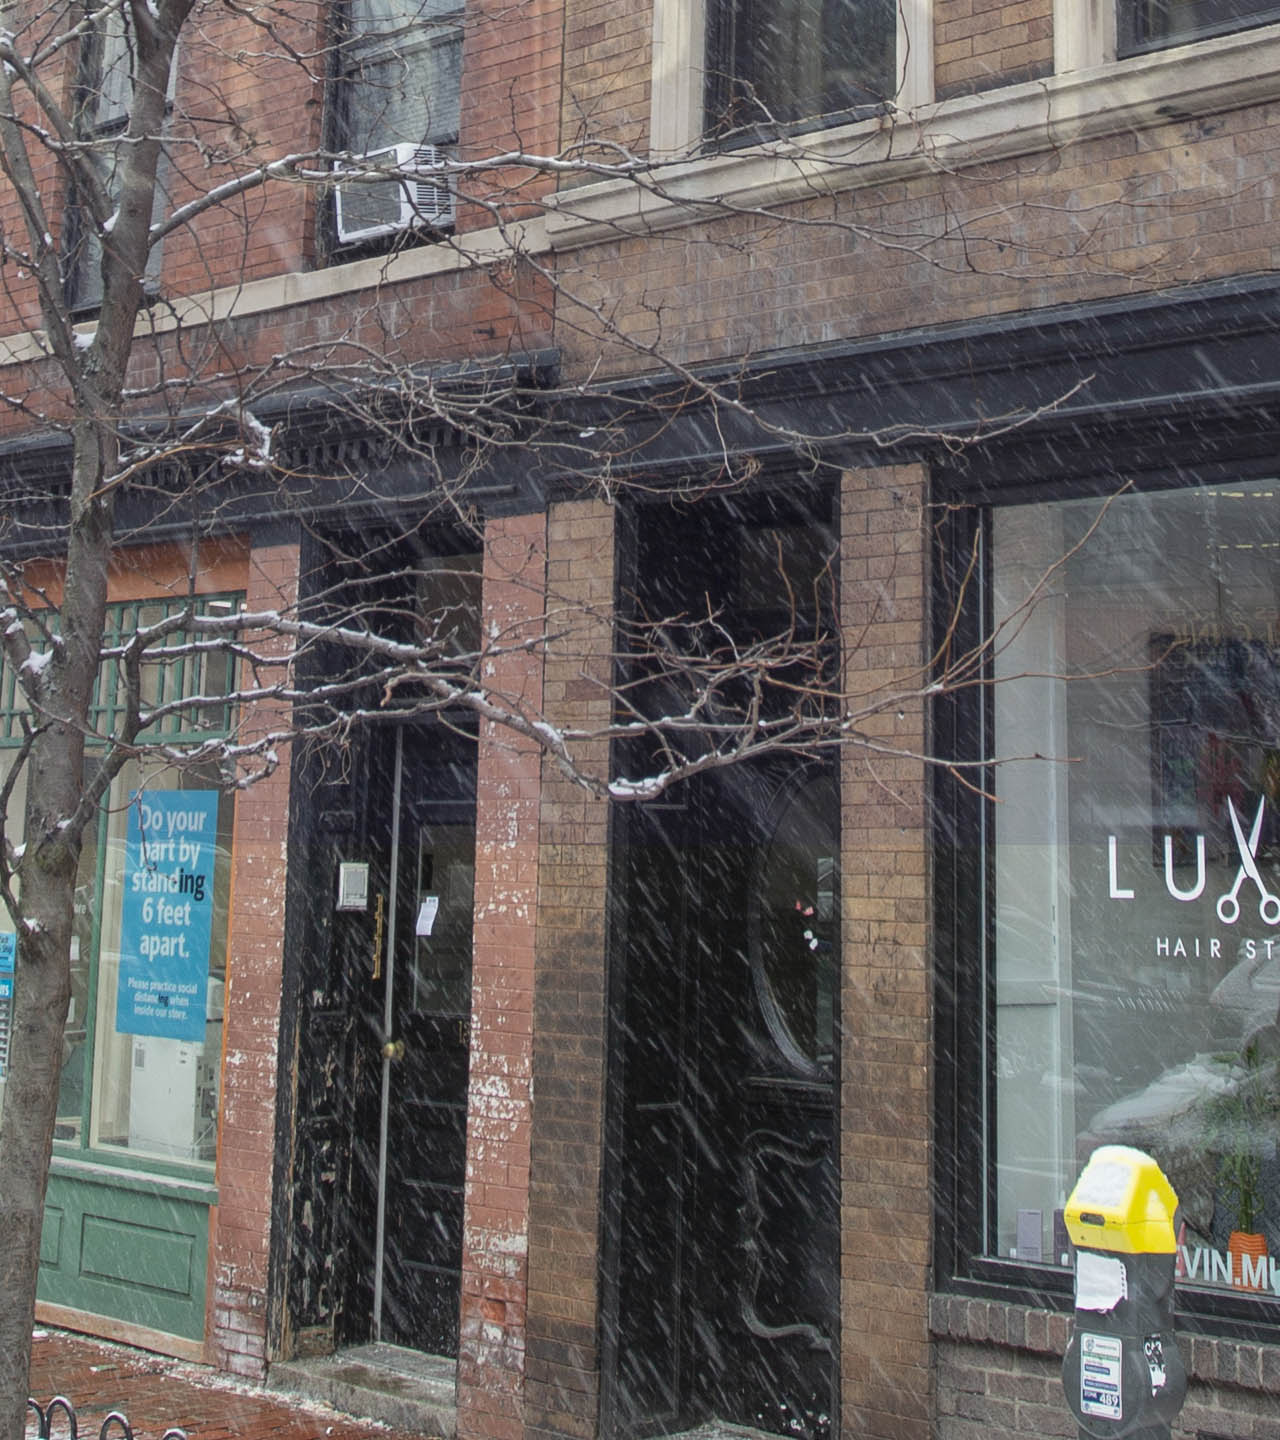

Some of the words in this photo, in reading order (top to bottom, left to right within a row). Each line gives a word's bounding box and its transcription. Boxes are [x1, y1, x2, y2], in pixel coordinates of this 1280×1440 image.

[138, 804, 163, 831] Do
[167, 810, 208, 838] your
[140, 839, 176, 867] part
[179, 836, 201, 870] by
[131, 867, 206, 902] standing
[142, 896, 154, 924] 6
[156, 898, 192, 927] feet
[139, 933, 190, 962] apart.
[1156, 936, 1222, 958] HAIR
[127, 977, 149, 990] Please
[150, 981, 177, 992] practice
[178, 983, 198, 995] social
[1100, 1392, 1119, 1407] 489
